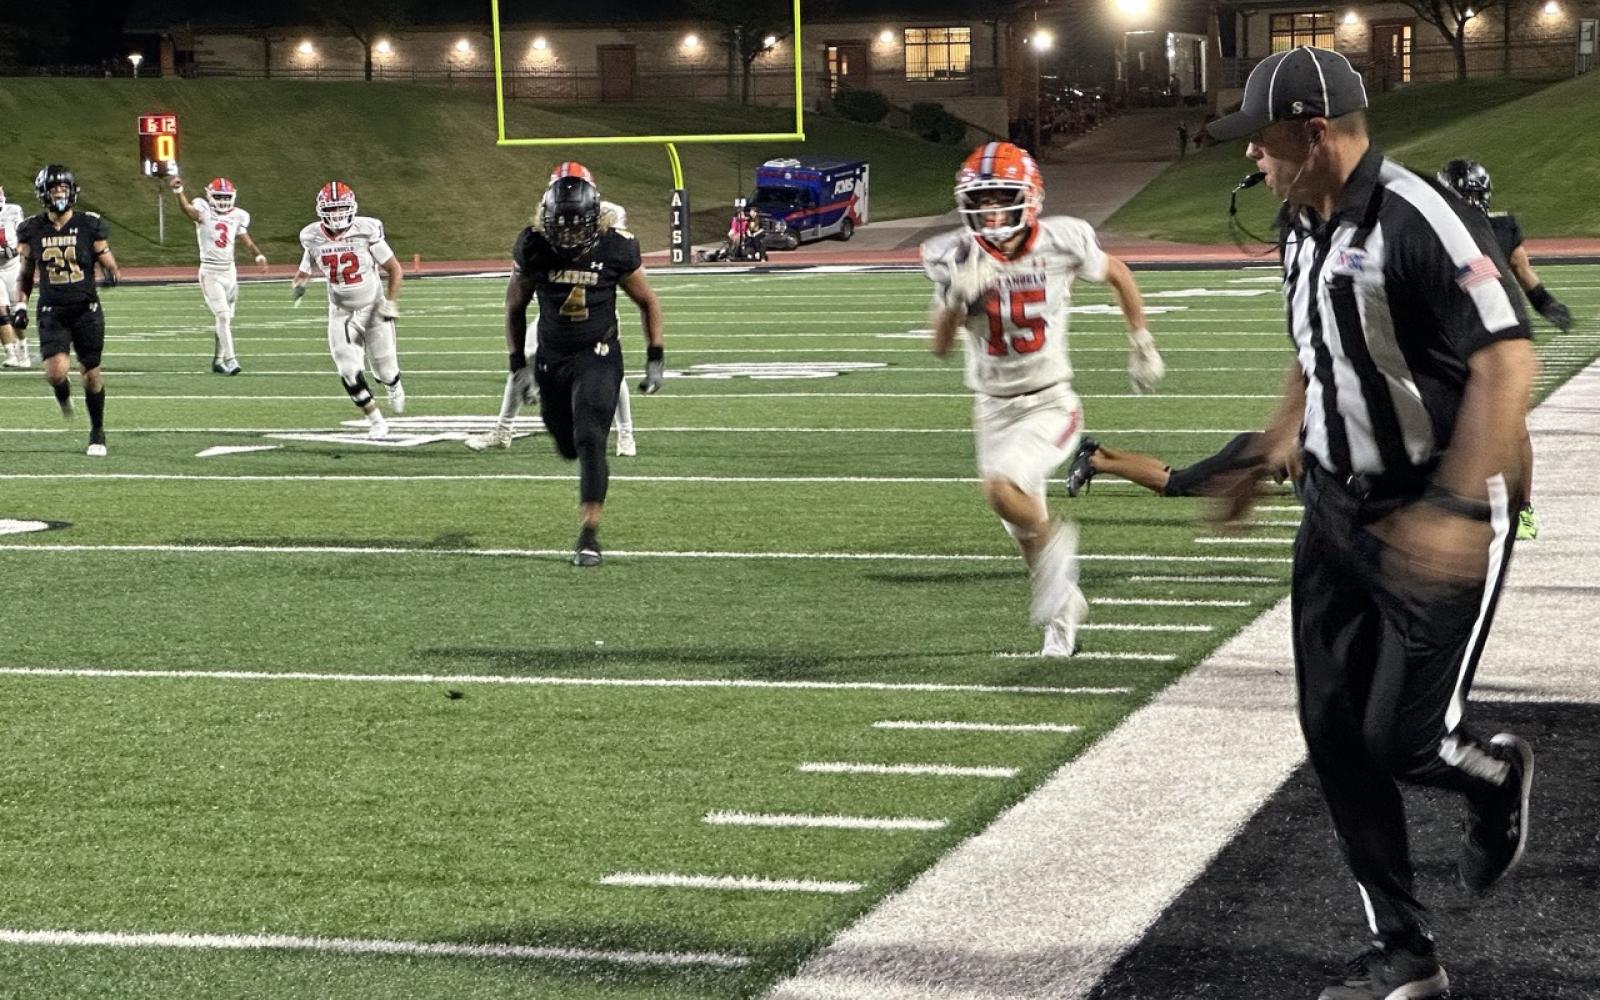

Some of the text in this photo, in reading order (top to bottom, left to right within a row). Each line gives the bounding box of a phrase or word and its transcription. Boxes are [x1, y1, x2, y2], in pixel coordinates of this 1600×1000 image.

[1292, 101, 1303, 114] S
[158, 135, 175, 161] 0
[215, 223, 228, 248] 3
[42, 246, 85, 285] 21
[321, 252, 363, 285] 72
[559, 286, 589, 321] 4
[984, 287, 1046, 357] 15
